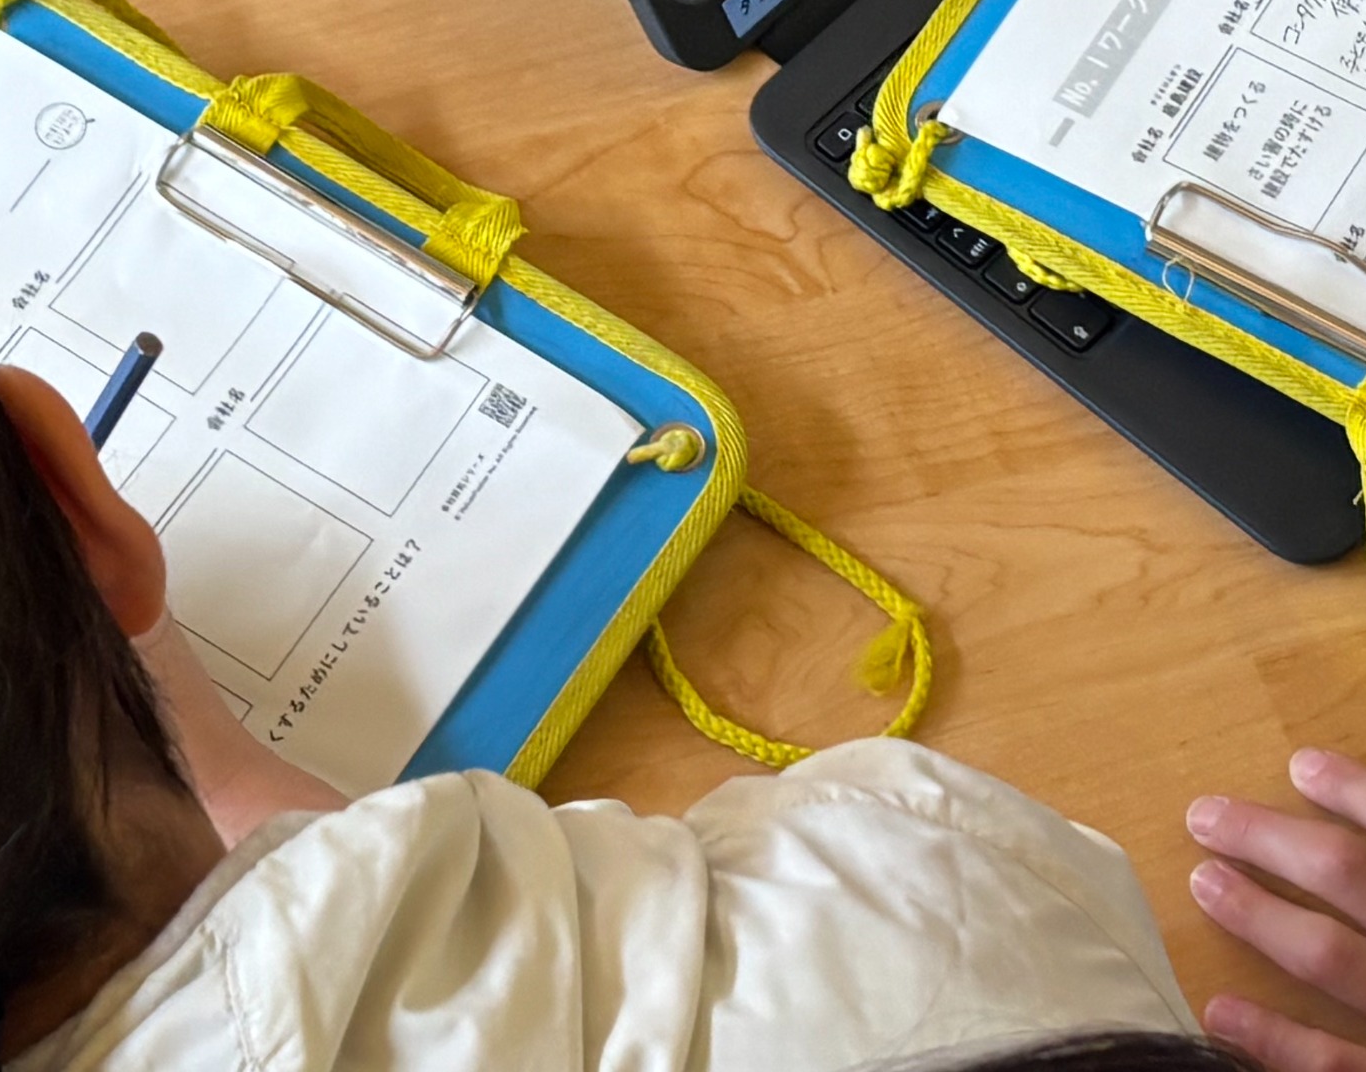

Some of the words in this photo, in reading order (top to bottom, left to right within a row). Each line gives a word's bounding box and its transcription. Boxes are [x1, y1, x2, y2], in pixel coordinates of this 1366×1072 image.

[1132, 127, 1164, 163] 会社名
[1203, 81, 1266, 162] 建物をつくる
[1261, 105, 1332, 199] 建設でたすける
[12, 270, 50, 310] 会社名
[205, 386, 248, 433] 会社名
[270, 539, 421, 742] くするためにしていることは？
